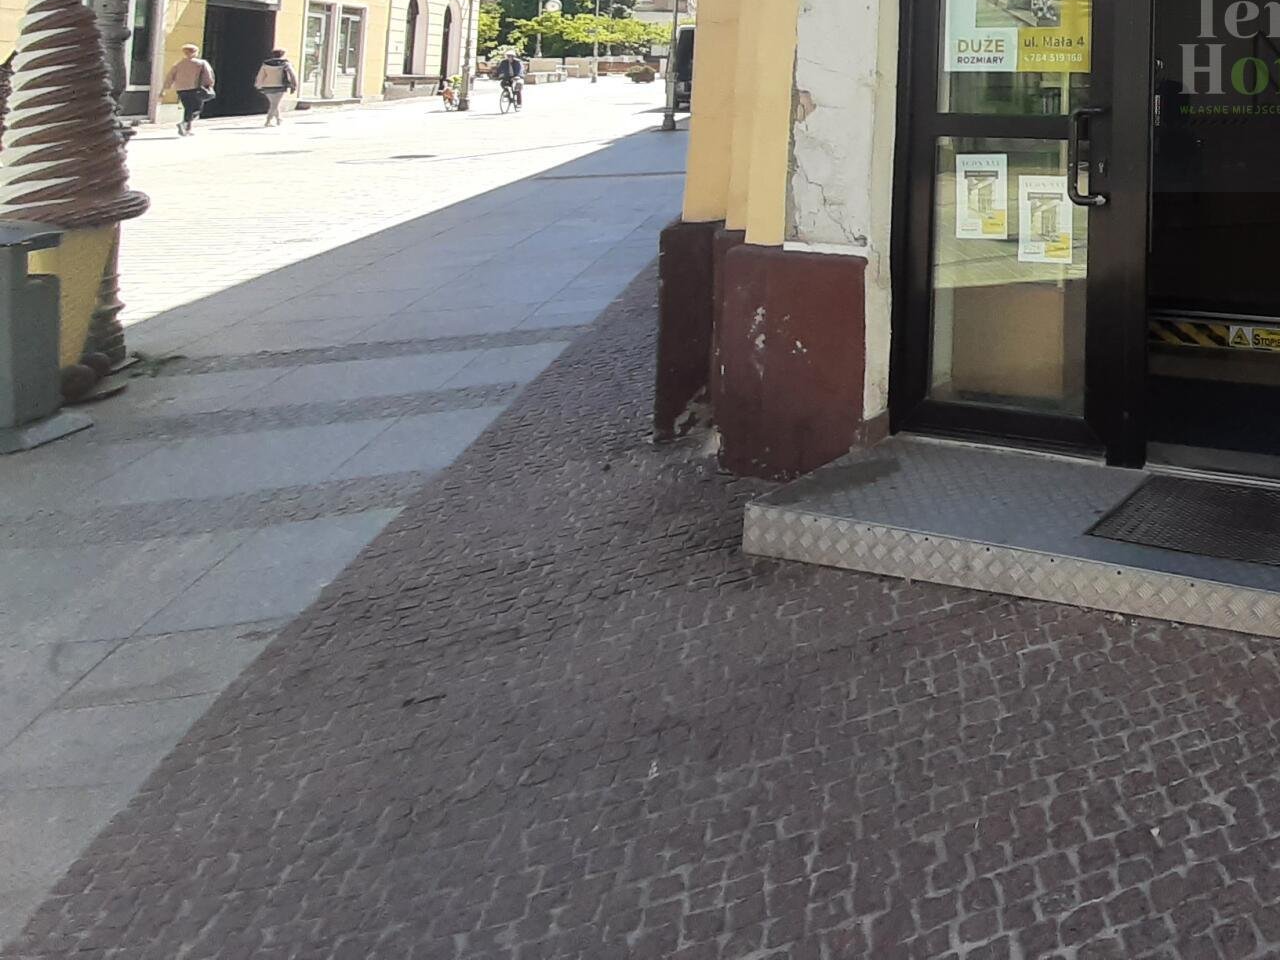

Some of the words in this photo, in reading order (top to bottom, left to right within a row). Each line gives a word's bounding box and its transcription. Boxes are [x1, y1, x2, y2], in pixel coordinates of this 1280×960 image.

[957, 35, 1005, 53] DUŻE
[1024, 37, 1039, 48] ul.
[1043, 36, 1073, 48] Mała
[1077, 36, 1086, 47] 4
[957, 56, 1005, 64] ROZMIARY
